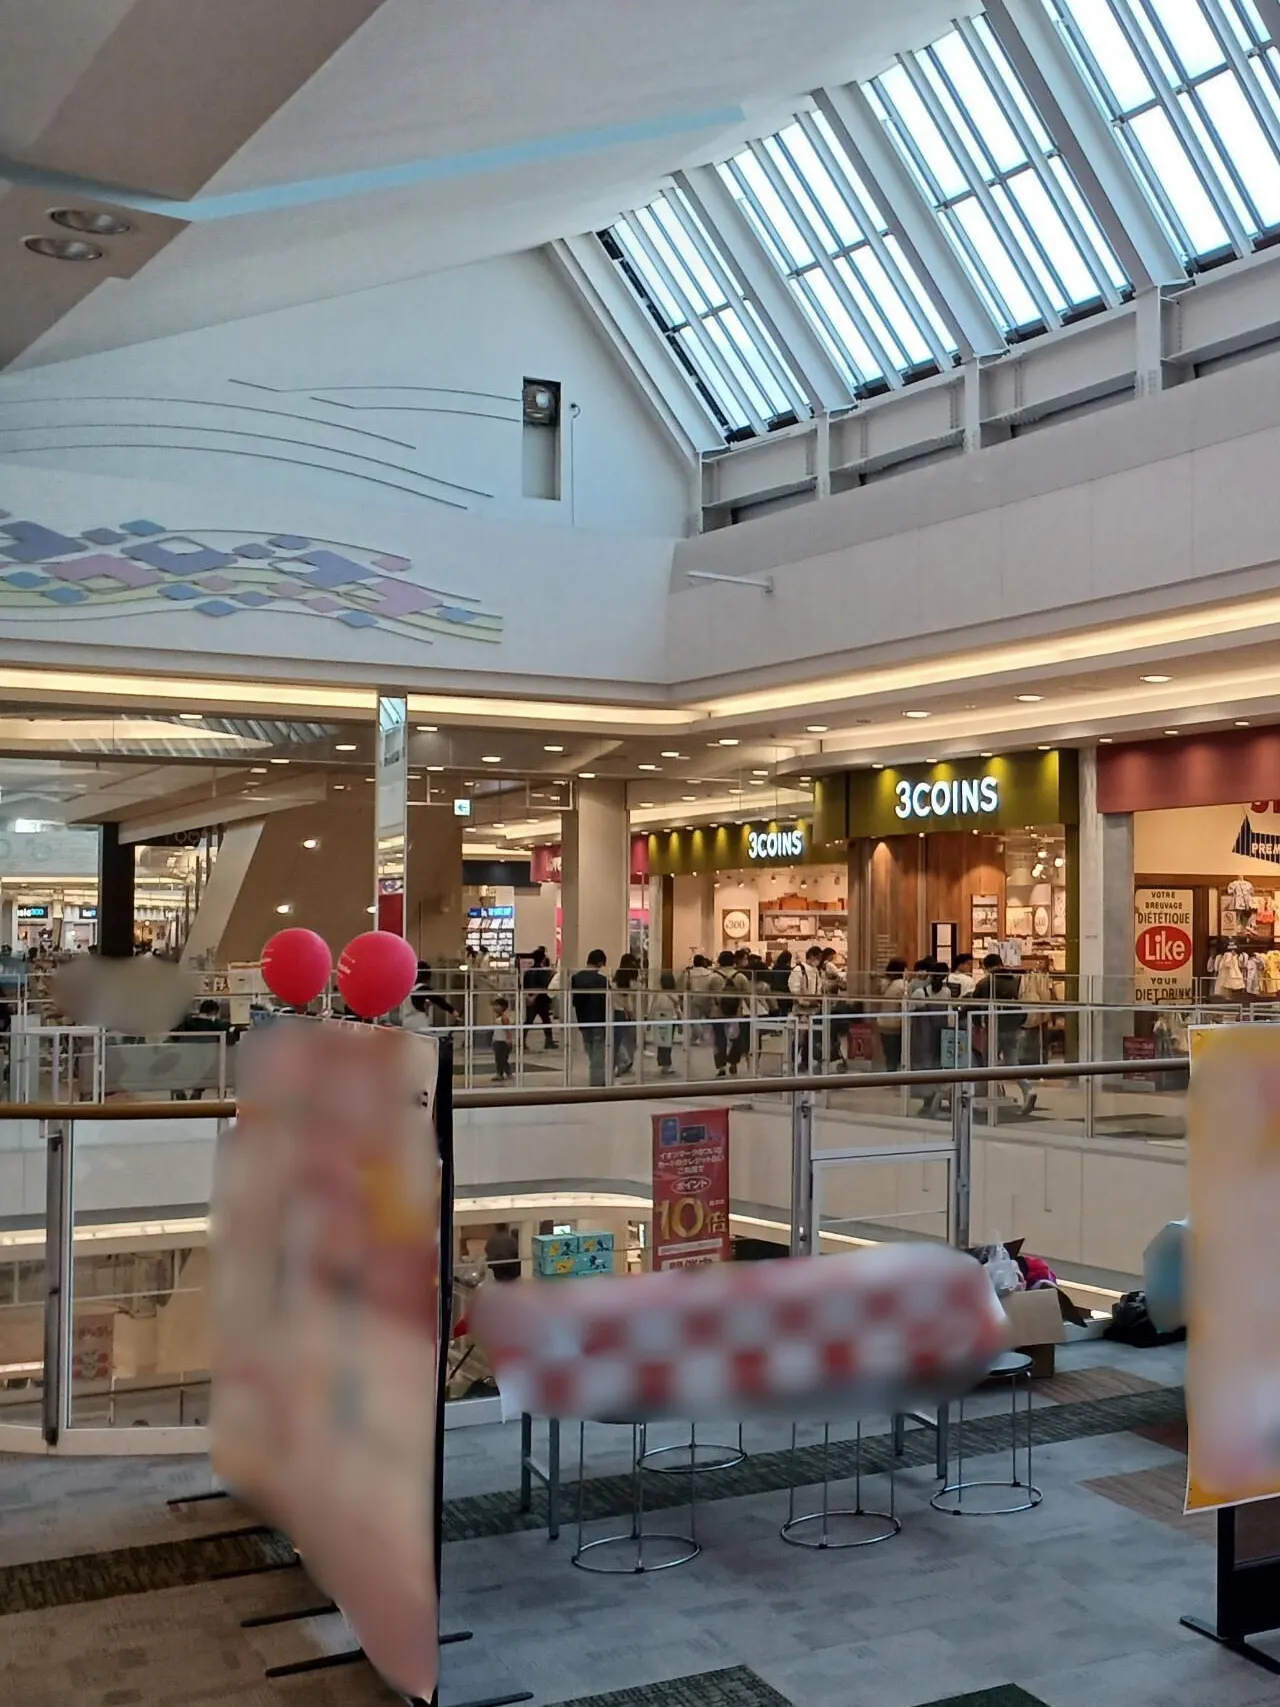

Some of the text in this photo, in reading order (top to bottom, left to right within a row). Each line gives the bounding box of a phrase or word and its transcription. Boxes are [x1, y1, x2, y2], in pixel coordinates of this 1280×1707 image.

[894, 776, 998, 819] 3COINS
[748, 830, 802, 858] 3COINS
[1151, 891, 1175, 899] VOTRE
[1145, 901, 1183, 910] BREUVAGE
[1144, 930, 1185, 961] Like
[1150, 977, 1177, 985] YOUR
[1135, 987, 1192, 1001] DIET DRINK
[675, 1180, 708, 1190] ポイント
